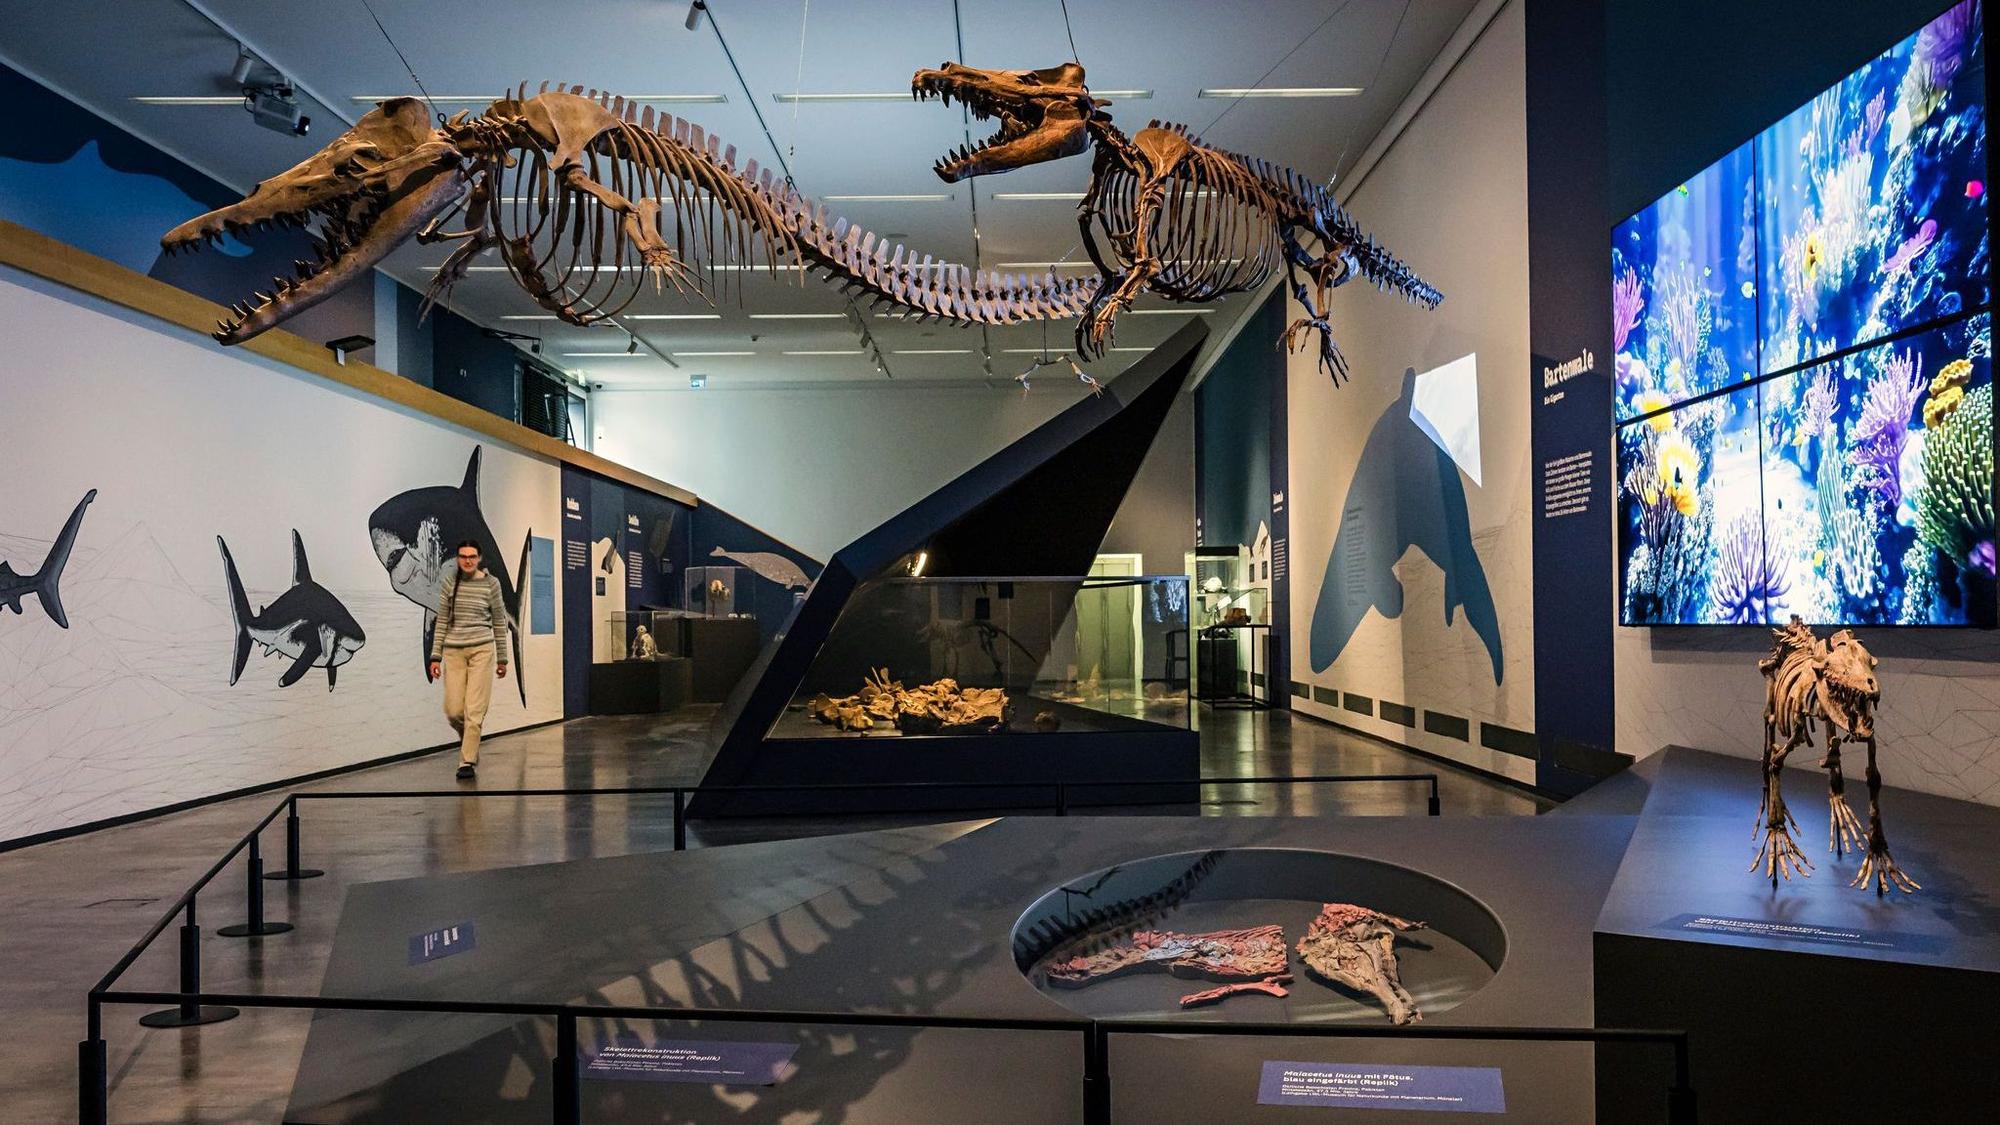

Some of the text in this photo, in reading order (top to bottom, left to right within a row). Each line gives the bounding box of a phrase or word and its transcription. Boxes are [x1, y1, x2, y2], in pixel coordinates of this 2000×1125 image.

[1544, 348, 1594, 388] Bartenwale
[603, 1046, 697, 1055] Skelettrekonstruktion
[686, 1054, 721, 1062] (Replik)
[1307, 1077, 1358, 1085] eingefärbt
[1360, 1078, 1399, 1087] (Replik)
